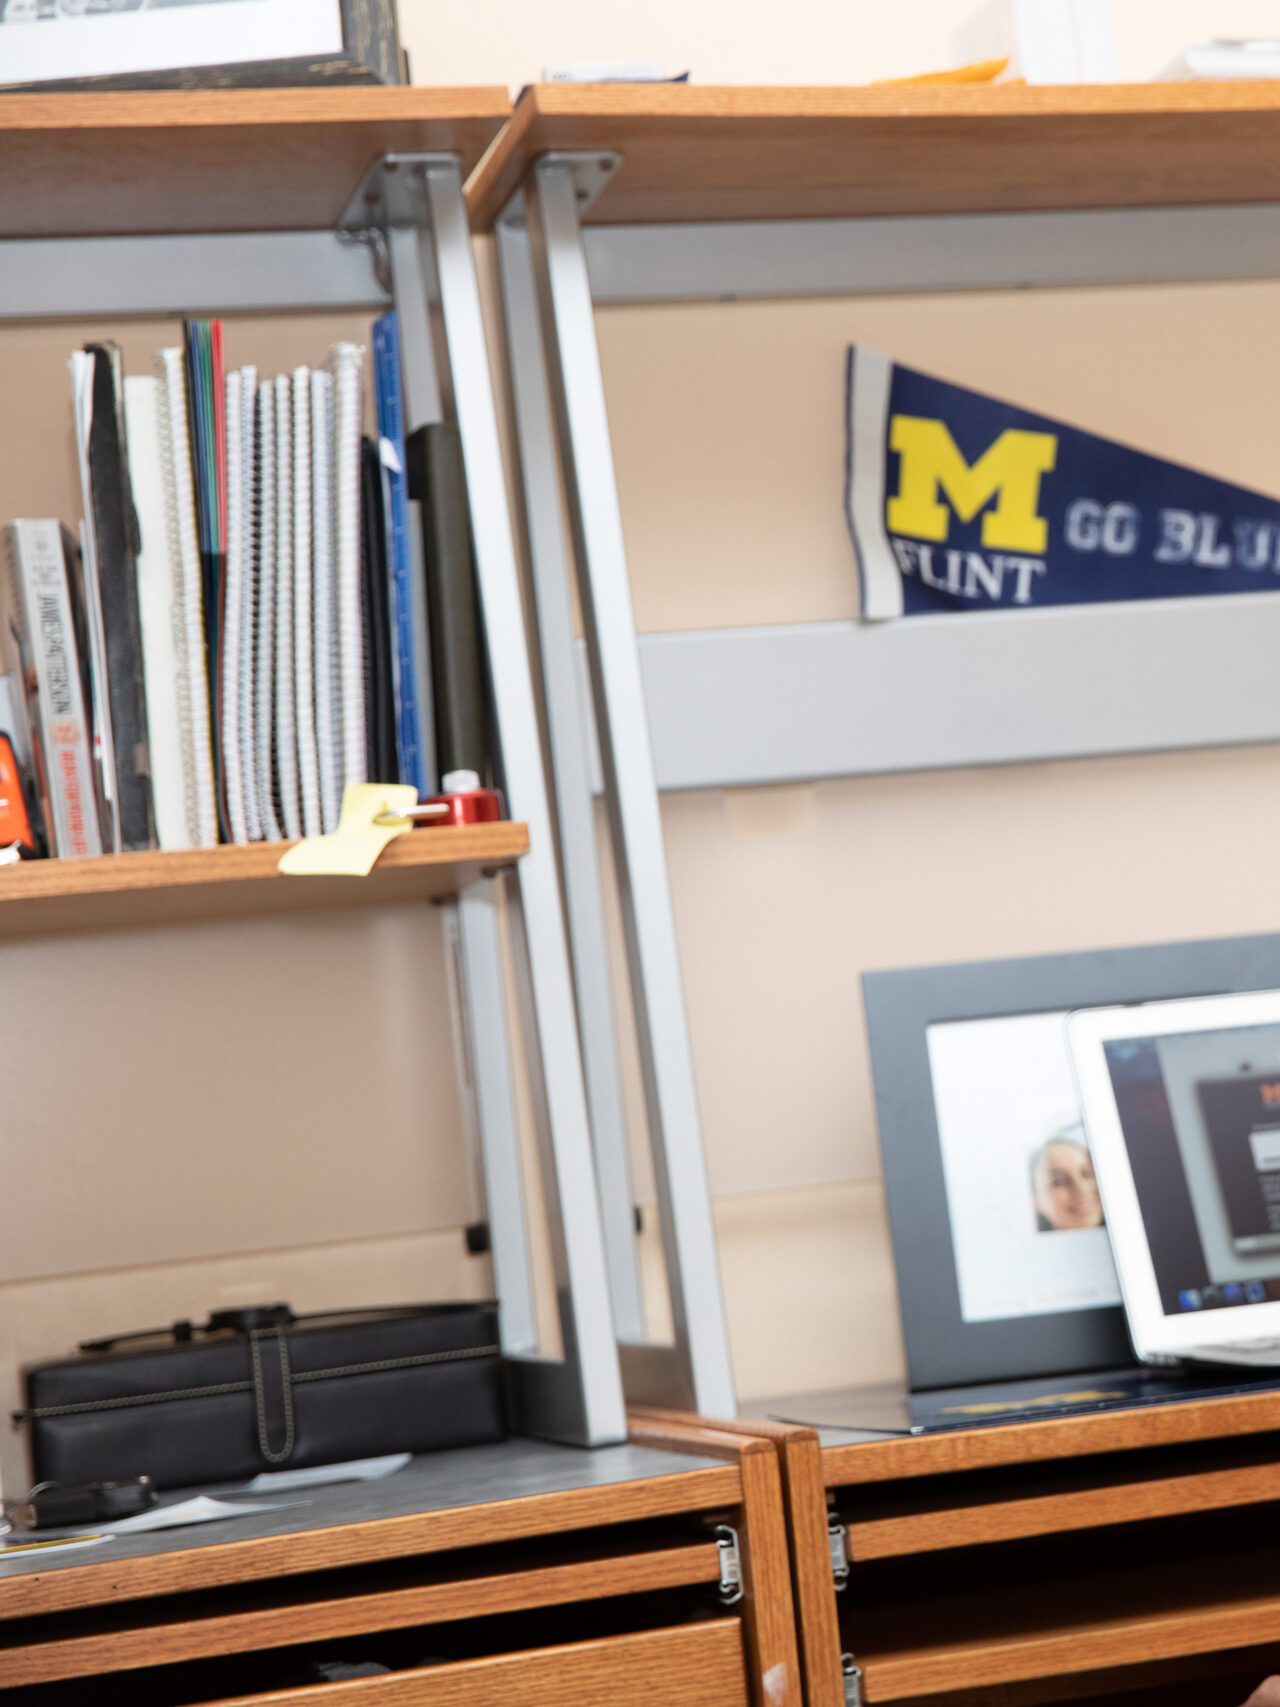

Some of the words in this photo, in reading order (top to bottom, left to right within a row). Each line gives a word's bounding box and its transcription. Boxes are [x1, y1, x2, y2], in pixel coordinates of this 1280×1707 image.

[887, 414, 1058, 556] M
[1065, 497, 1141, 556] GO
[891, 533, 1047, 605] FLINT
